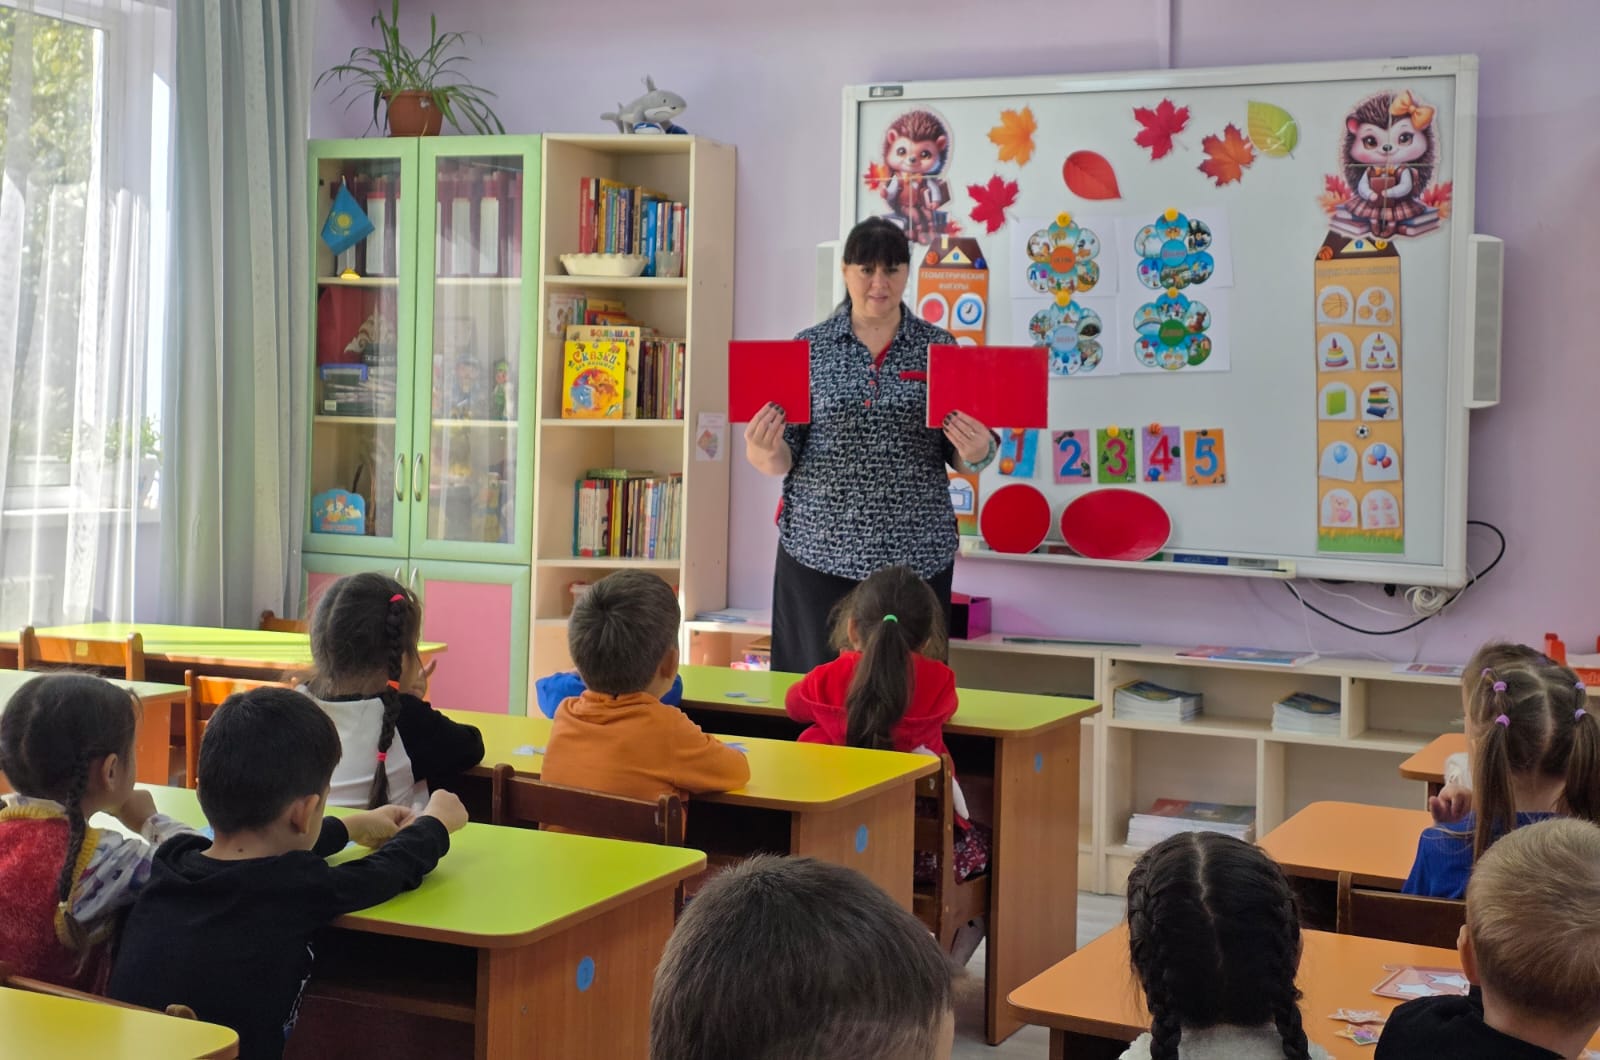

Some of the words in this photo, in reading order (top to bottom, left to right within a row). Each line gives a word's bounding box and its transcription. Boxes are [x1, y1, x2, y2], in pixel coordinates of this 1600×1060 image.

[590, 329, 635, 338] БОЛЬШАЯ
[1010, 431, 1026, 463] 1
[1059, 438, 1084, 477] 2
[1106, 438, 1128, 477] 3
[1149, 434, 1174, 473] 4
[1194, 437, 1219, 477] 5
